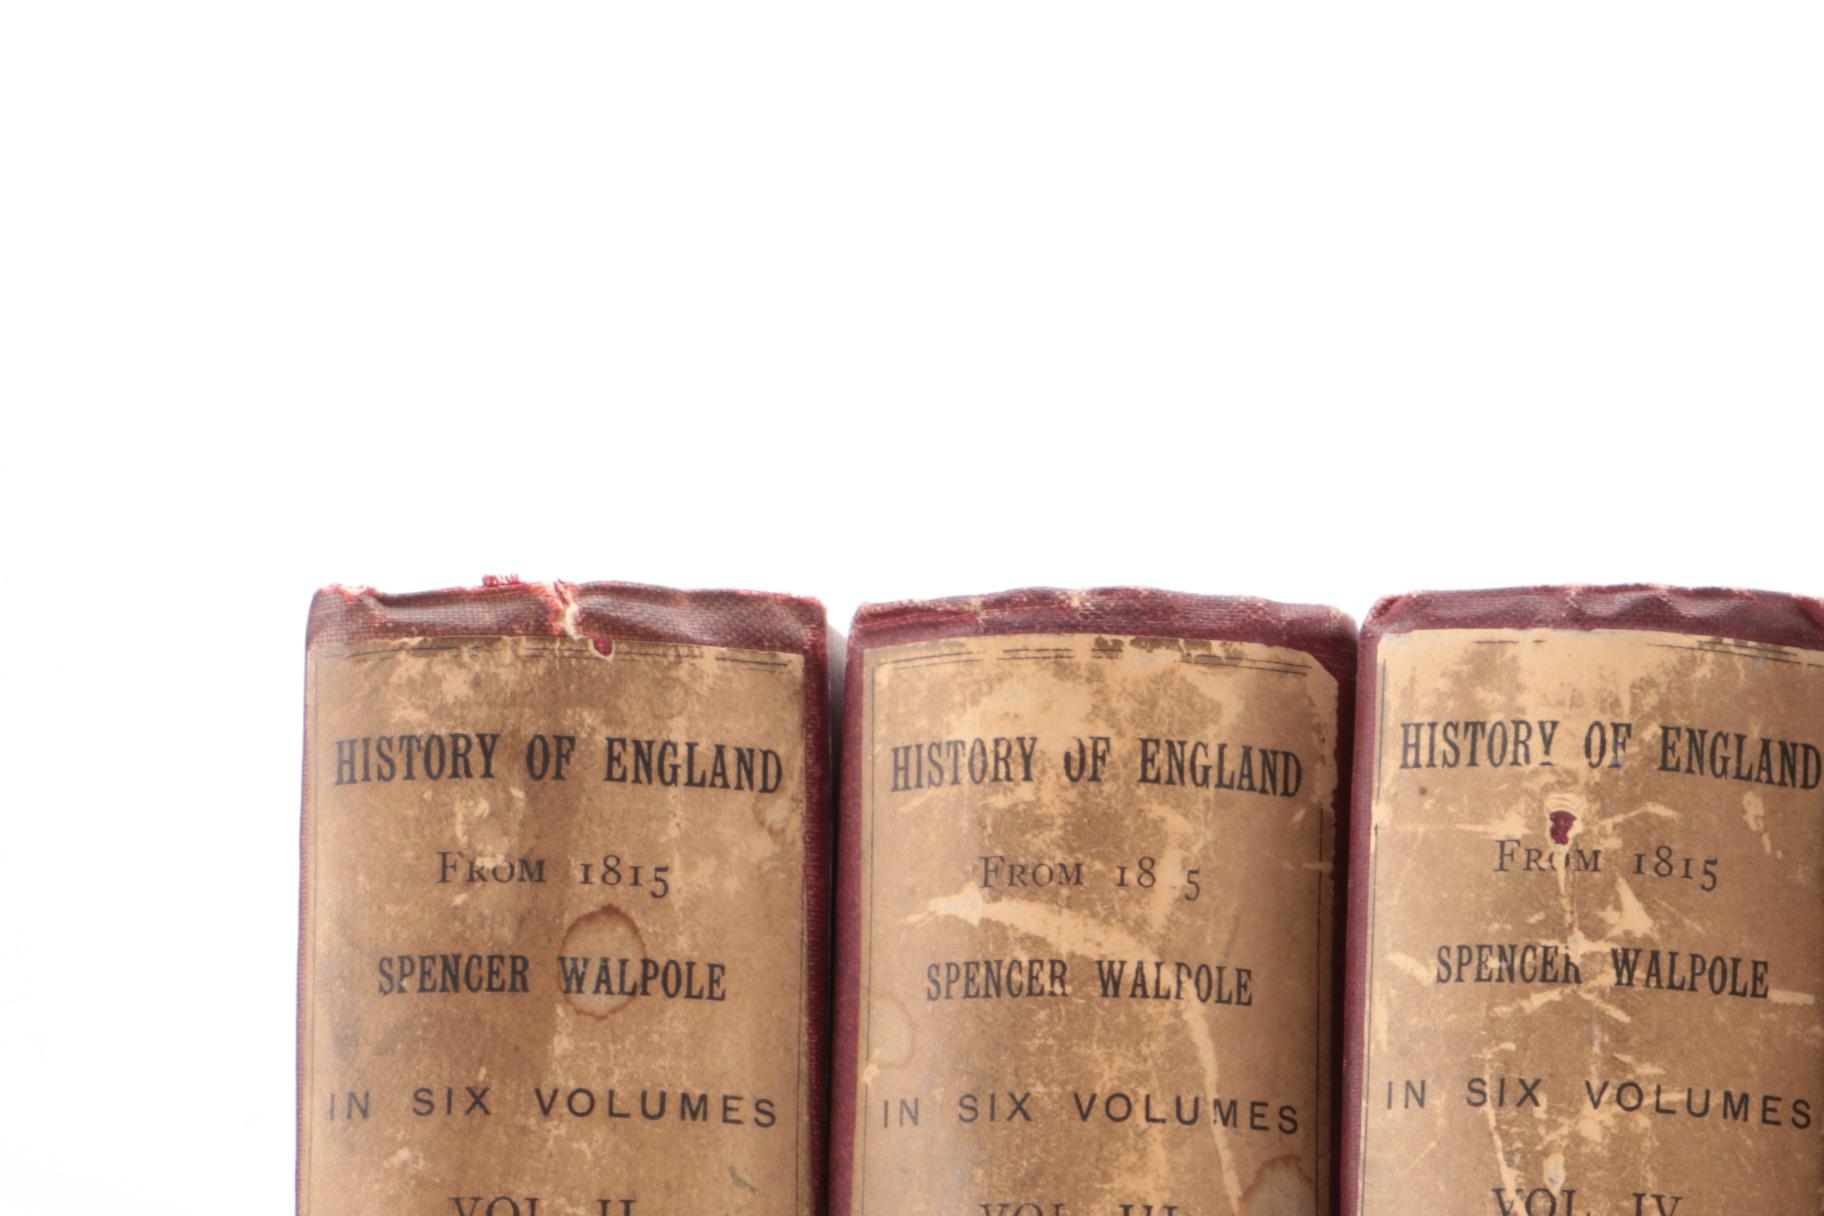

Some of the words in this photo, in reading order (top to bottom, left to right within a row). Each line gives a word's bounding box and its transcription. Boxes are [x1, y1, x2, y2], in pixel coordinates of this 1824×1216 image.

[336, 733, 500, 786] HISTORY
[527, 736, 576, 782] OF
[604, 738, 782, 795] ENGLAND
[891, 737, 1038, 792] HISTORY
[1065, 737, 1110, 782] OF
[1138, 738, 1302, 798] ENGLAND
[1401, 720, 1559, 769] HISTORY
[1584, 722, 1632, 768] OF
[1659, 725, 1821, 790] ENGLAND
[580, 855, 670, 898] 1815
[1116, 857, 1200, 900] 185
[1634, 846, 1719, 890] 1815
[378, 954, 529, 996] SPENCER
[559, 956, 725, 1001] WALPOLE
[927, 959, 1068, 1002] SPENCER
[1098, 961, 1253, 1006] WALPOLE
[1436, 945, 1582, 984] SPENCER
[1610, 947, 1768, 999] WALPOLE
[329, 1091, 370, 1121] IN
[413, 1088, 492, 1116] SIX
[536, 1088, 777, 1128] VOLUMES
[883, 1100, 920, 1128] IN
[959, 1093, 1031, 1123] SIX
[1073, 1093, 1298, 1134] VOLUMES
[1387, 1080, 1426, 1109] IN
[1467, 1077, 1542, 1108] SIX
[1585, 1080, 1812, 1129] VOLUMES
